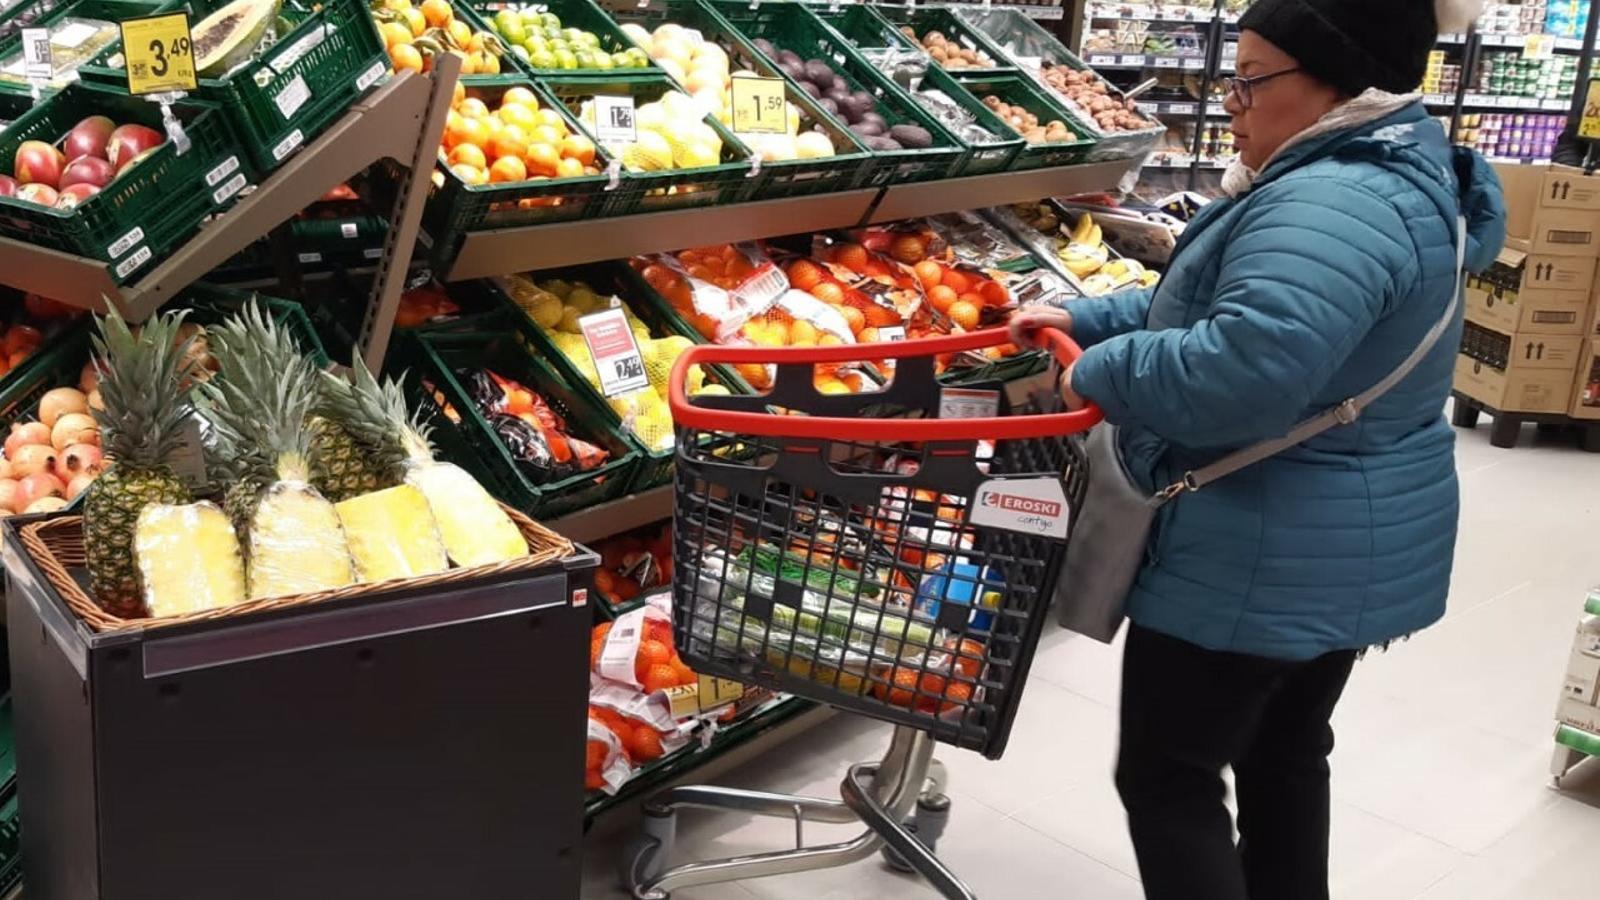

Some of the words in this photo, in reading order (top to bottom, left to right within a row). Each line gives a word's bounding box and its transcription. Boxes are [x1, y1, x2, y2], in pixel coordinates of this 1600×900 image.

[149, 37, 190, 77] 3,49
[752, 95, 783, 122] 1,59
[1004, 497, 1057, 515] EROSKI
[1017, 516, 1053, 532] contigo
